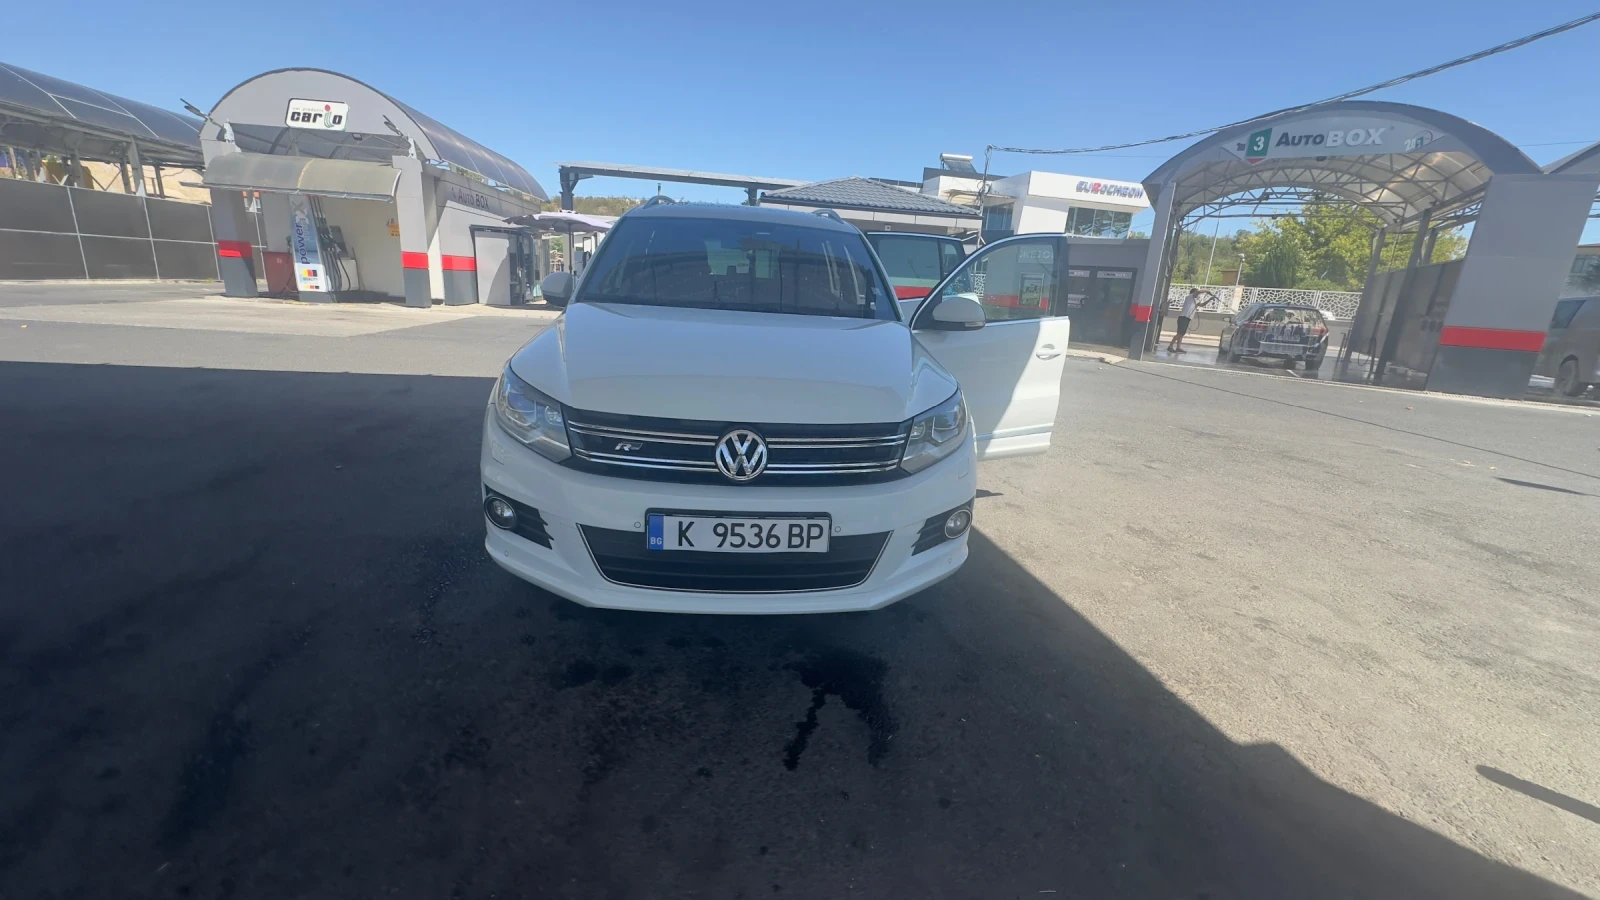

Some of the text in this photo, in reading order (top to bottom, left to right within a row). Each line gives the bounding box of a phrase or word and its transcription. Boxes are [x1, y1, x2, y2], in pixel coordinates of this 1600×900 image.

[1253, 136, 1265, 152] 3
[295, 221, 310, 265] power
[650, 536, 663, 546] BG
[677, 520, 824, 549] K 9536 BP
